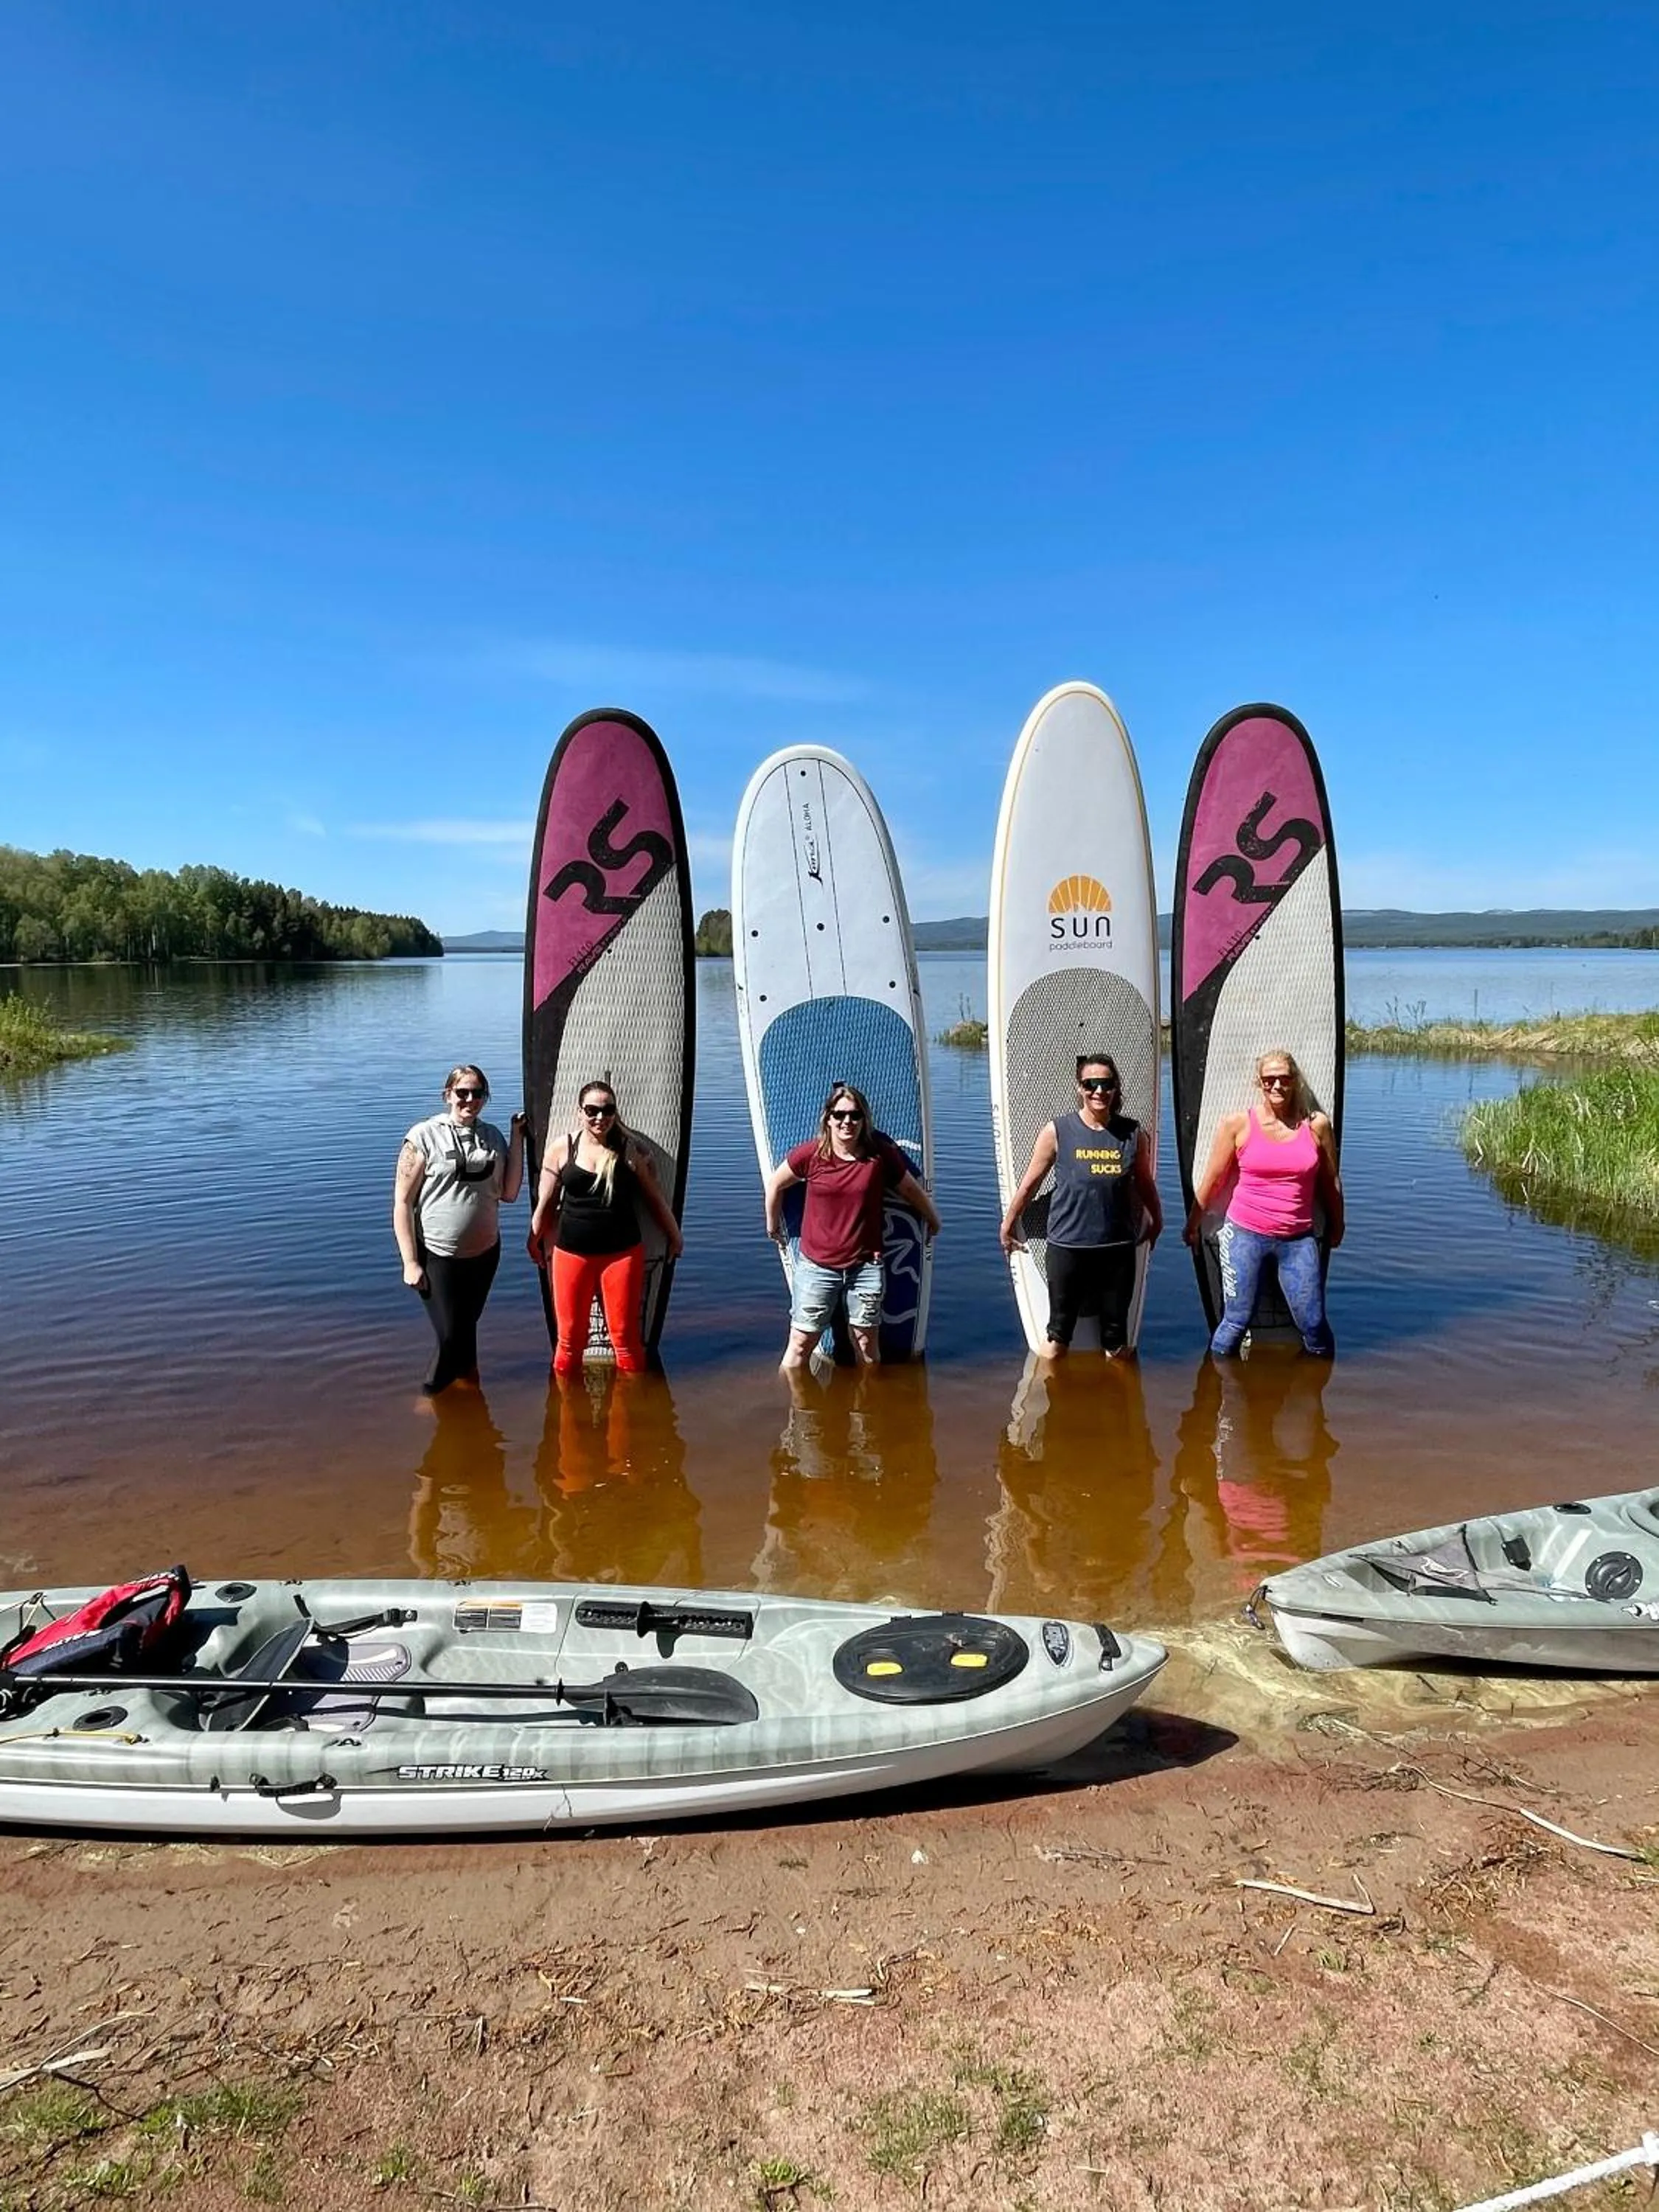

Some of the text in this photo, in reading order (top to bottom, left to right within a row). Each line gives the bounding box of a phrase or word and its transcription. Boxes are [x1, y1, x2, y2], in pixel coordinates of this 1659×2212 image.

[802, 801, 812, 831] ALOHA
[1049, 940, 1112, 953] paddleboard
[1076, 1149, 1121, 1159] RUNNING
[1091, 1164, 1121, 1174] SUCKS
[398, 1764, 503, 1779] STRIKE
